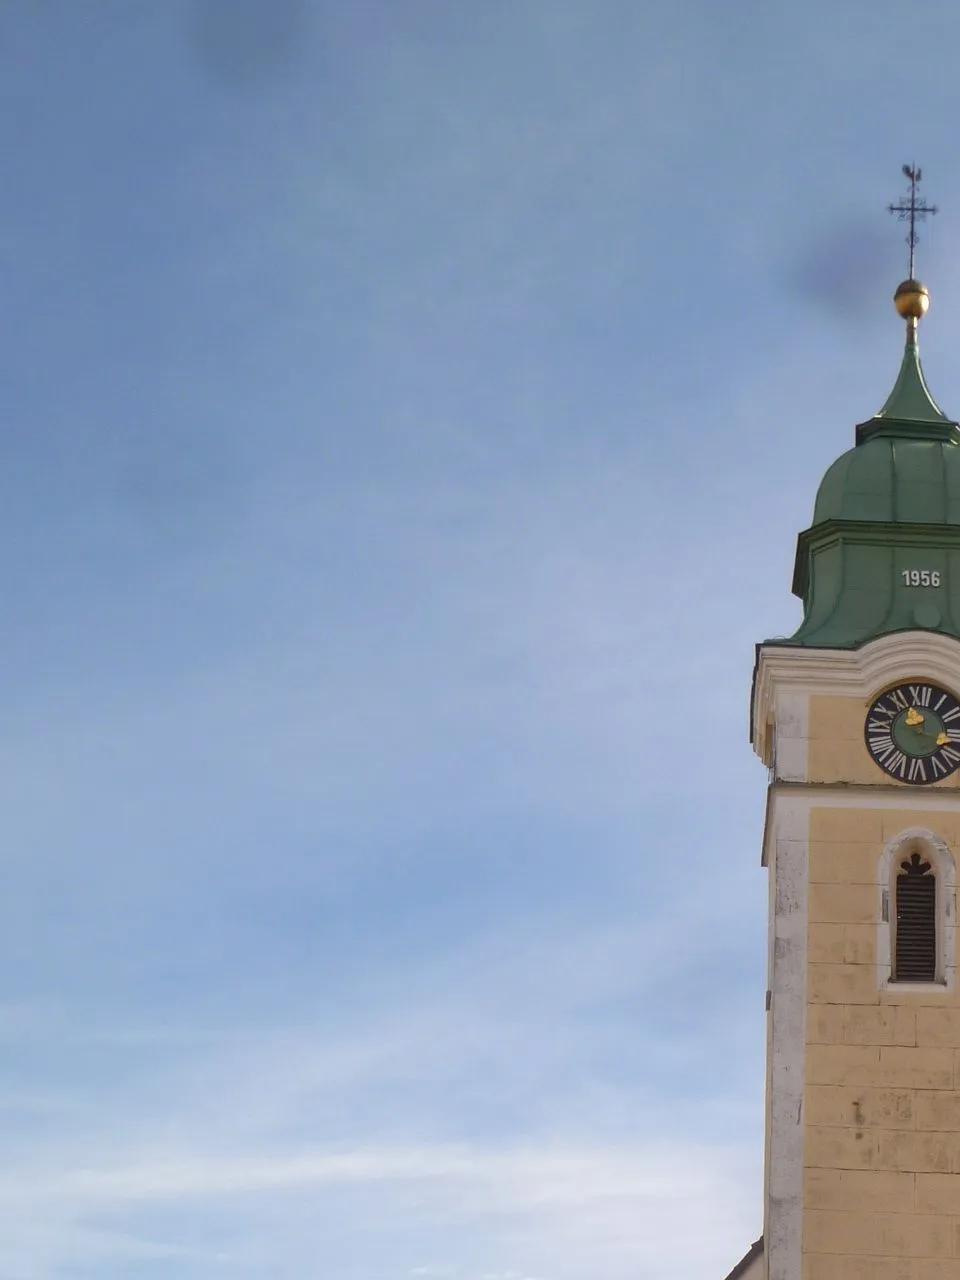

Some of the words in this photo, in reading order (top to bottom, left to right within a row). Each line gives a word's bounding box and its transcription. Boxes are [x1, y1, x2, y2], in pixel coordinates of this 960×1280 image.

[902, 570, 940, 587] 1956
[886, 689, 909, 712] XI
[909, 686, 932, 706] XII
[933, 694, 947, 711] I
[873, 702, 897, 719] X
[868, 717, 893, 732] IX
[868, 735, 895, 762] VIII
[884, 750, 907, 778] VII
[908, 758, 926, 780] VI
[931, 756, 948, 777] V
